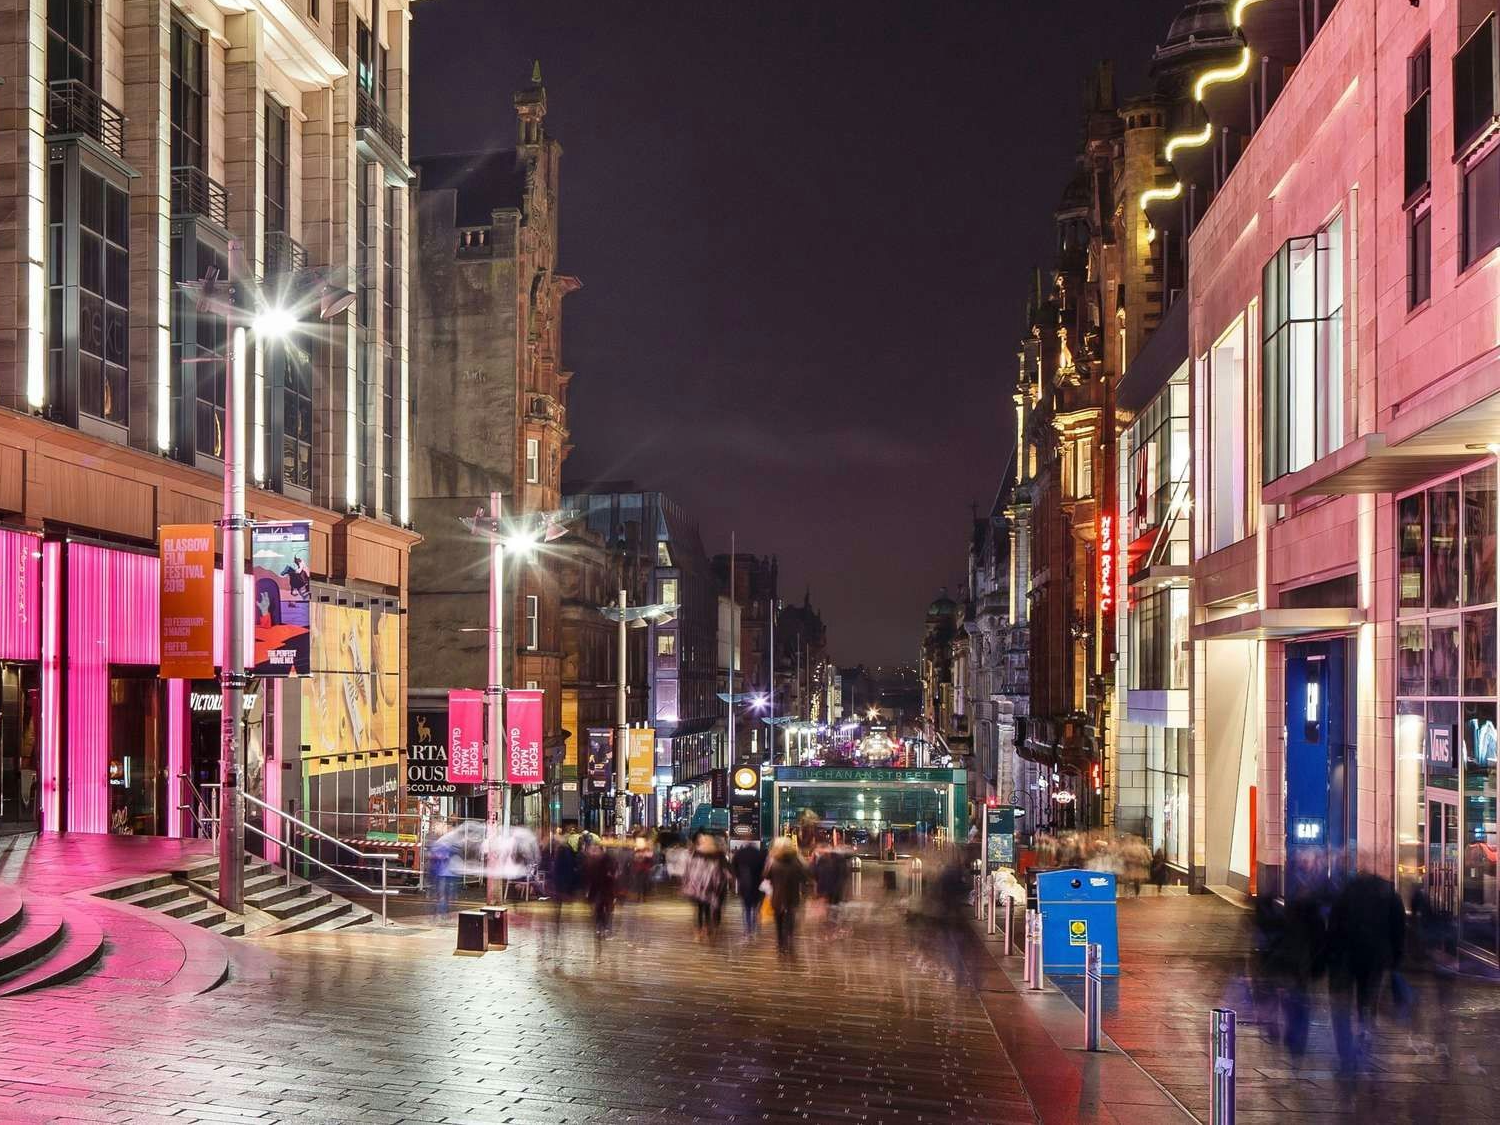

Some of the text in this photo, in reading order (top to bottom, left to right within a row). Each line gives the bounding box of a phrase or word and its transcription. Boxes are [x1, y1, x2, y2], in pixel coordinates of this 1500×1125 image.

[163, 538, 210, 552] GLASGOW
[163, 552, 186, 566] FILM
[163, 565, 206, 579] FESTIVAL
[163, 579, 186, 592] 2019
[452, 727, 461, 775] GLASGOW
[470, 741, 479, 775] PEOPLE
[511, 728, 520, 776] GLASGOW
[529, 741, 539, 776] PEOPLE
[1430, 729, 1449, 762] VANS
[461, 748, 470, 775] MAKE
[520, 749, 530, 776] MAKE
[796, 770, 931, 780] BUCHANAN STREET
[406, 784, 457, 793] SCOTLAND
